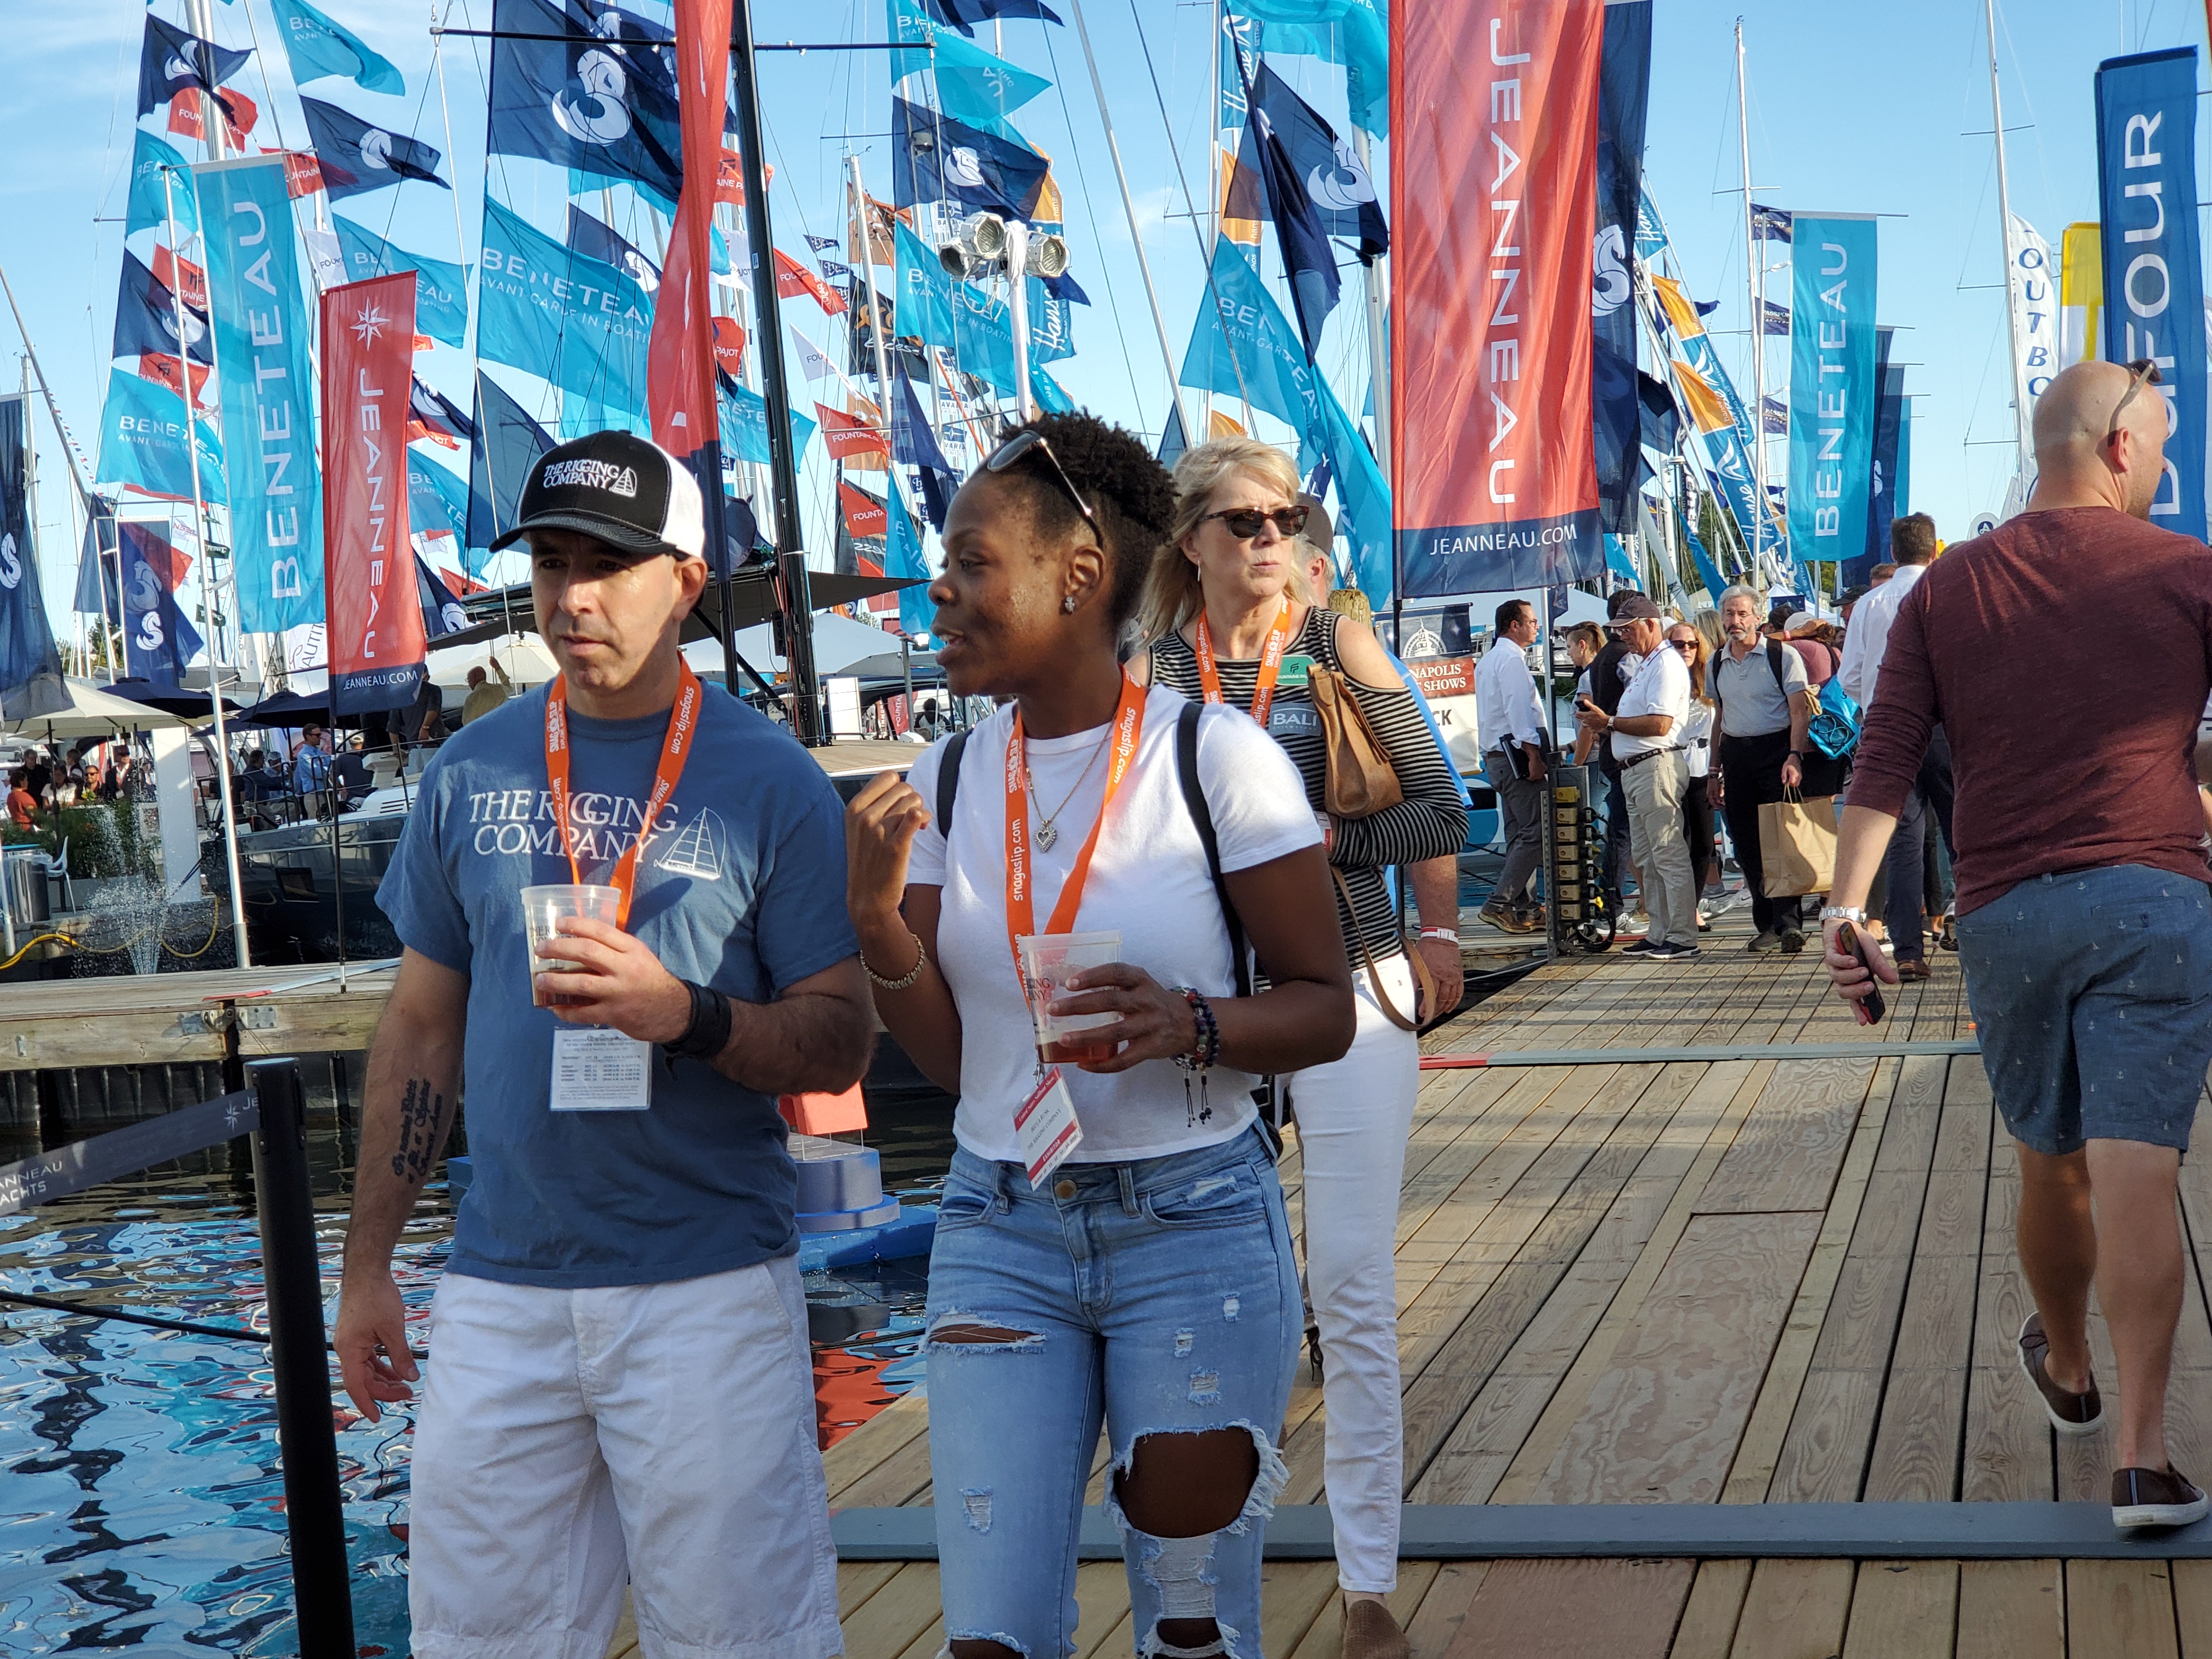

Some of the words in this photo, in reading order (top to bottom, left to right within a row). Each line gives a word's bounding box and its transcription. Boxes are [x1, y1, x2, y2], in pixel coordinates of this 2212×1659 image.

[1488, 18, 1531, 504] JEANNEAU
[603, 320, 646, 343] BOATI
[2124, 111, 2181, 516] DFOUR
[981, 324, 1012, 345] BOATIN
[234, 201, 302, 599] BENETEAU
[1815, 242, 1848, 537] BENETEAU
[543, 472, 611, 489] COMPANY
[544, 461, 565, 477] THE
[563, 459, 620, 478] RIGGING
[358, 368, 385, 658] JEANNEAU
[853, 510, 884, 521] FOUNTA
[1430, 523, 1578, 556] JEANNEAU.COM
[342, 669, 418, 691] JEANNEAU.COM
[1423, 676, 1466, 692] SHOWS
[670, 685, 695, 754] snagaslip.com
[1273, 713, 1317, 727] BALI
[1113, 707, 1136, 785] snagaslip.com
[469, 789, 532, 823] THE
[534, 790, 680, 832] RGGING
[473, 823, 659, 864] COMPANY
[1012, 819, 1025, 901] snagaslip.com
[1042, 1139, 1061, 1161] EXHIBITOR
